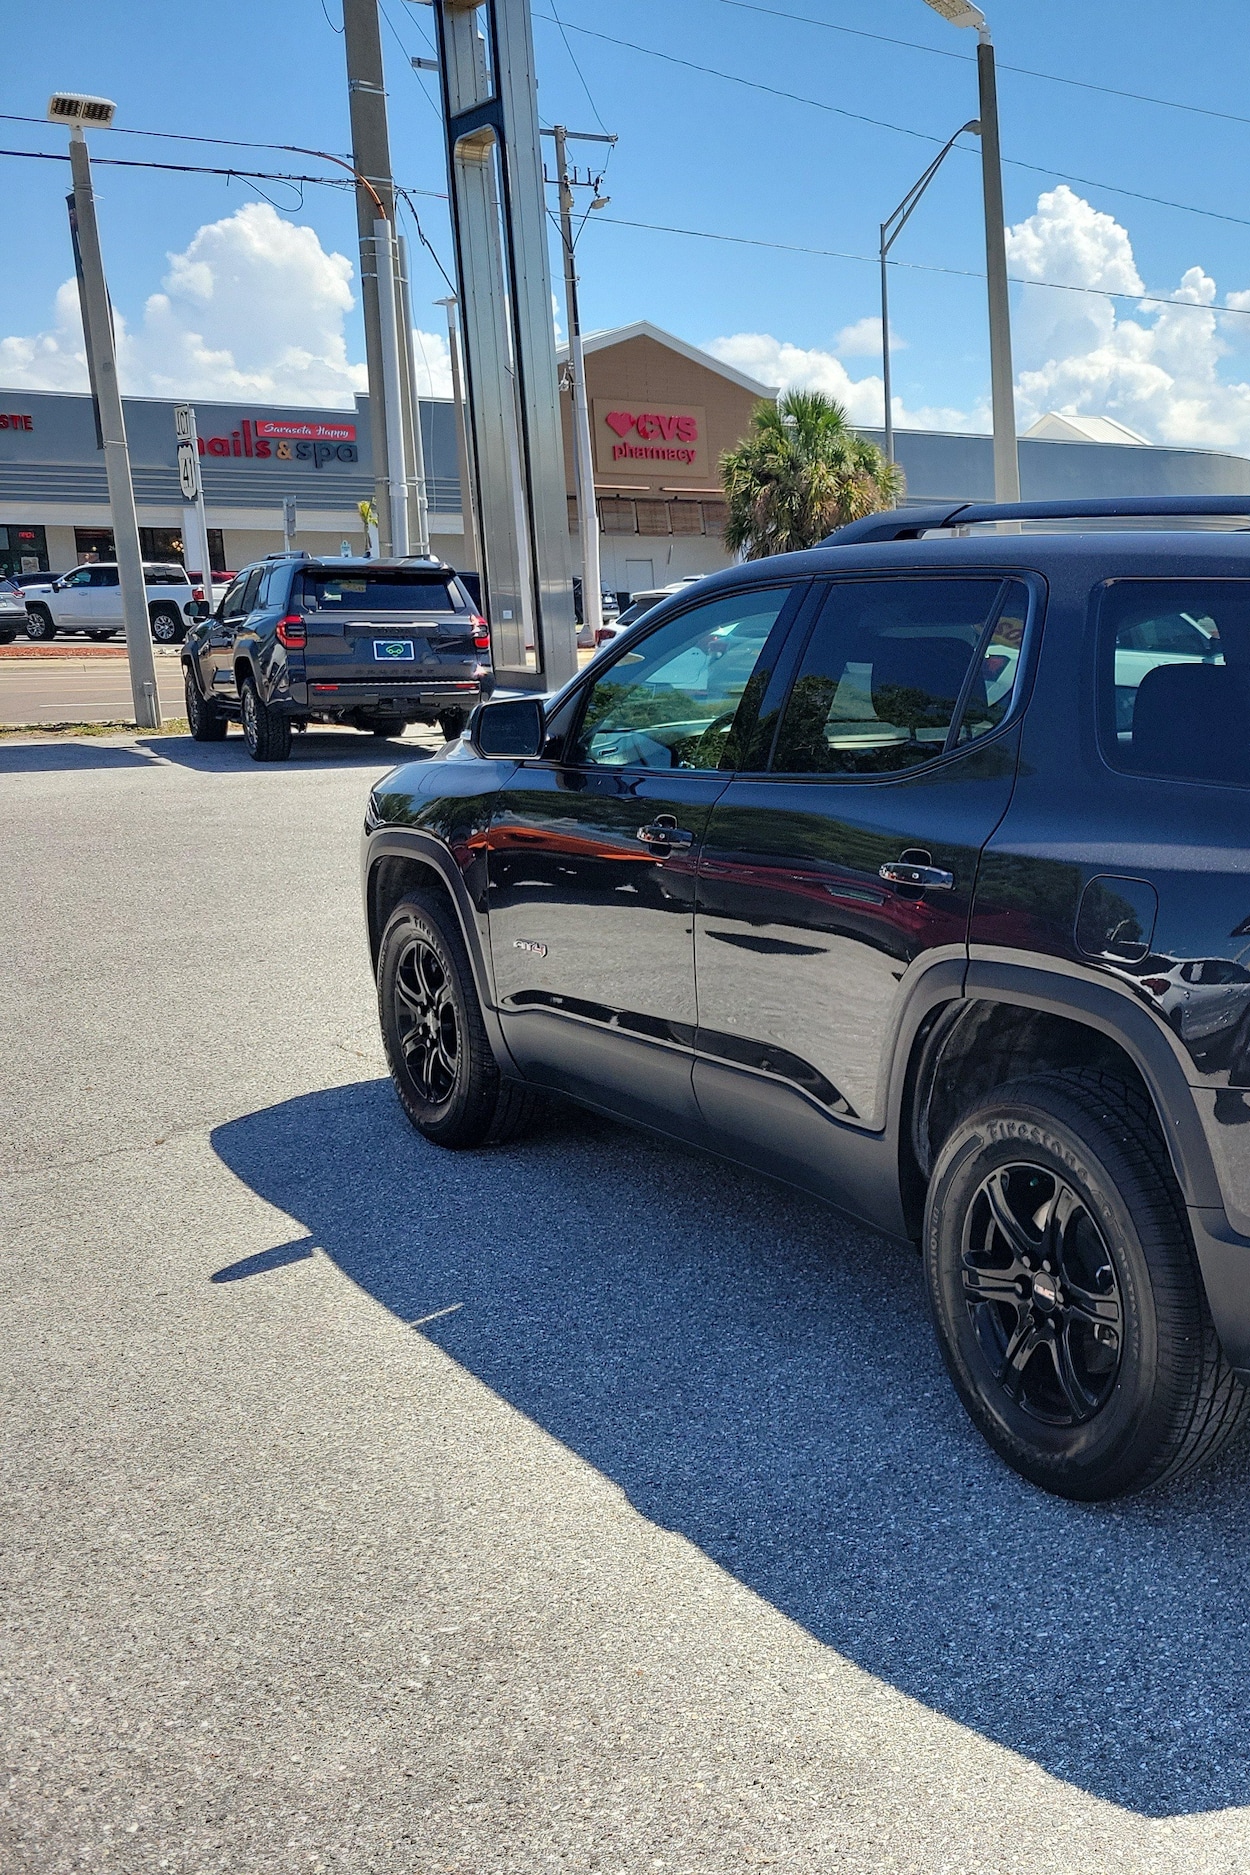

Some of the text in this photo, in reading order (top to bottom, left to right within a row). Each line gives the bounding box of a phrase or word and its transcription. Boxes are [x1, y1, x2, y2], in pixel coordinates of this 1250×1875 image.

[263, 423, 350, 438] Sarasota Happy
[636, 413, 698, 443] CVS
[276, 440, 293, 461] &
[296, 442, 359, 469] spa
[612, 441, 697, 465] pharmacy
[182, 458, 195, 489] 41
[512, 937, 548, 958] AT4
[986, 1119, 1089, 1183] Firestone
